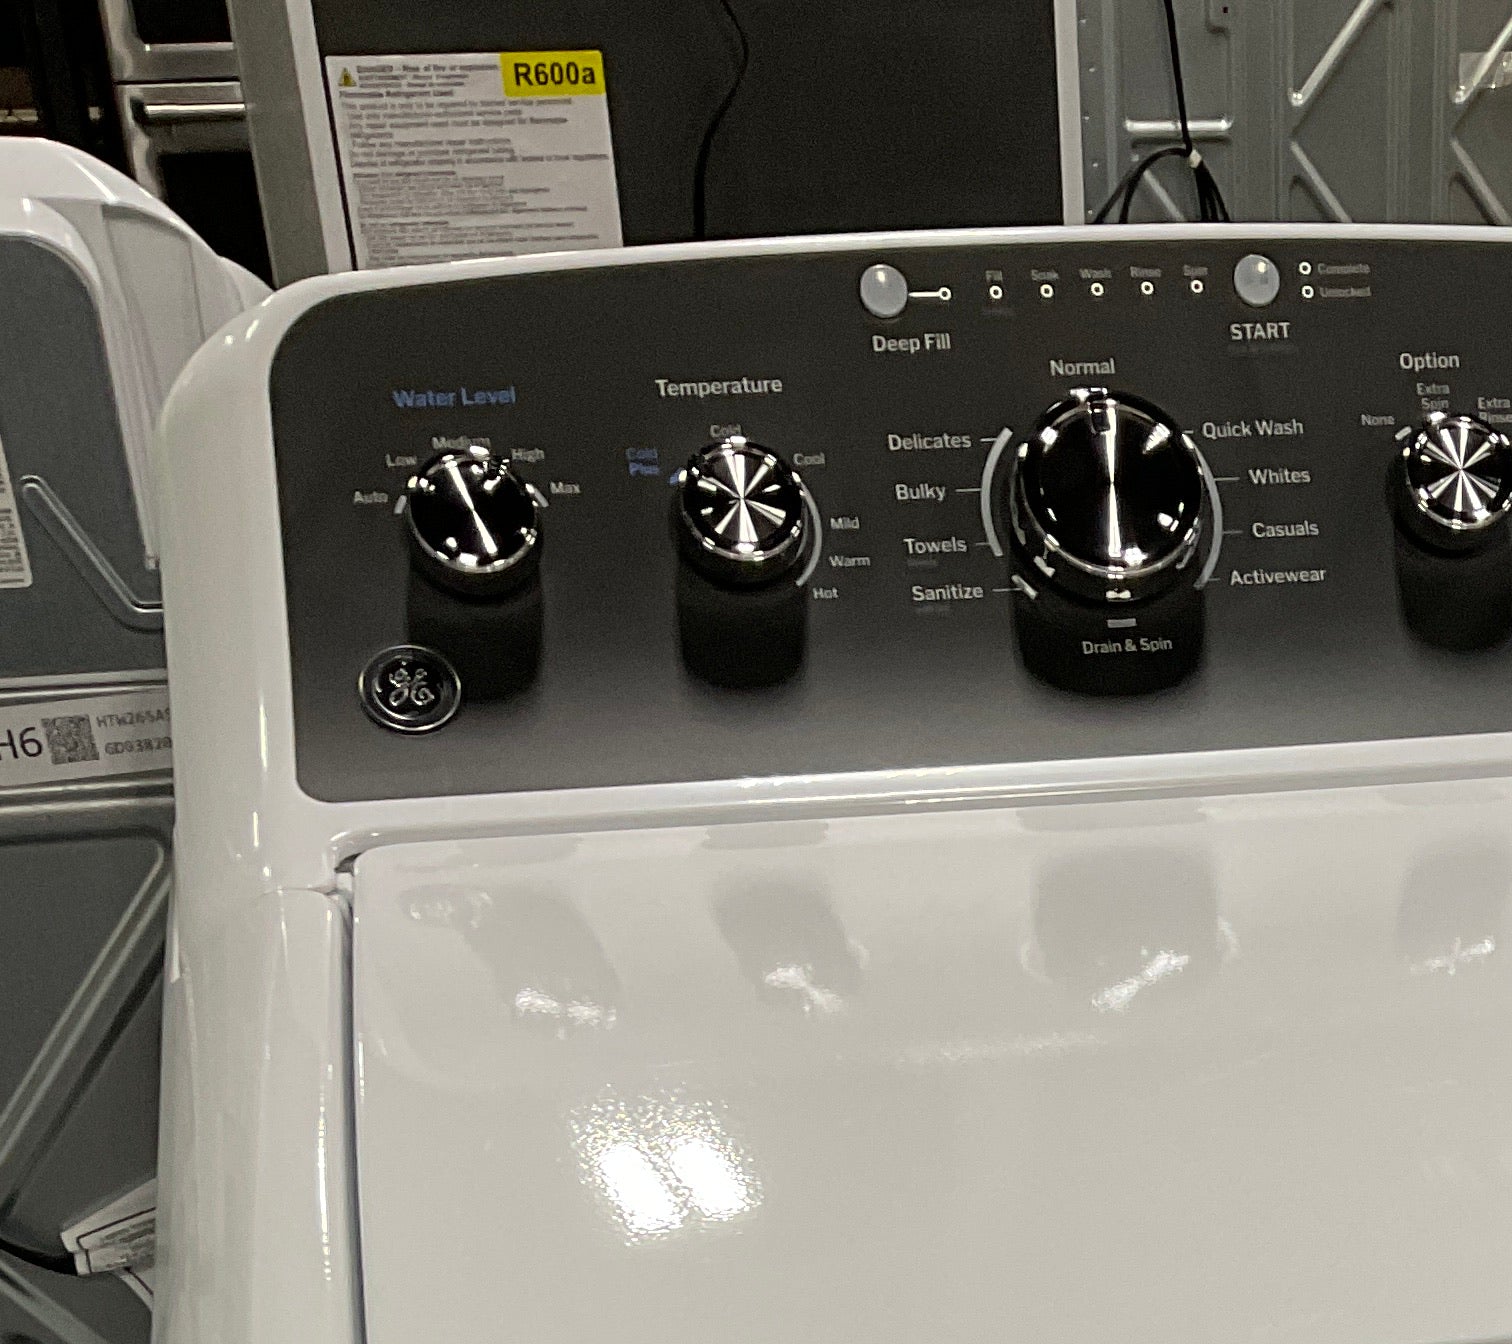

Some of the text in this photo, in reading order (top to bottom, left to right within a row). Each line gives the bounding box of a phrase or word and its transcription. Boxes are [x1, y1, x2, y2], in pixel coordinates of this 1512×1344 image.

[513, 61, 596, 87] R600a
[1229, 321, 1291, 341] START
[872, 333, 951, 354] Deep Fill
[1049, 358, 1116, 377] Normal
[1400, 352, 1460, 372] Option
[392, 385, 516, 408] Water Level
[655, 376, 783, 399] Temperature
[1416, 383, 1450, 396] Extra
[1477, 396, 1511, 410] Extra
[1202, 418, 1304, 440] Quick Wash
[1361, 414, 1395, 426] None
[888, 432, 972, 451] Delicates
[385, 453, 418, 468] Low
[793, 452, 825, 466] Cool
[1248, 468, 1311, 485] Whites
[549, 480, 580, 495] Max
[895, 483, 946, 502] Bulky
[353, 490, 389, 505] Auto
[830, 516, 859, 530] Mild
[1252, 520, 1320, 538] Casuals
[903, 536, 968, 554] Towels
[829, 555, 871, 568] Warm
[1230, 567, 1327, 587] Activewear
[813, 587, 838, 600] Hot
[911, 583, 984, 601] Sanitize
[1082, 636, 1173, 655] Drain & Spin
